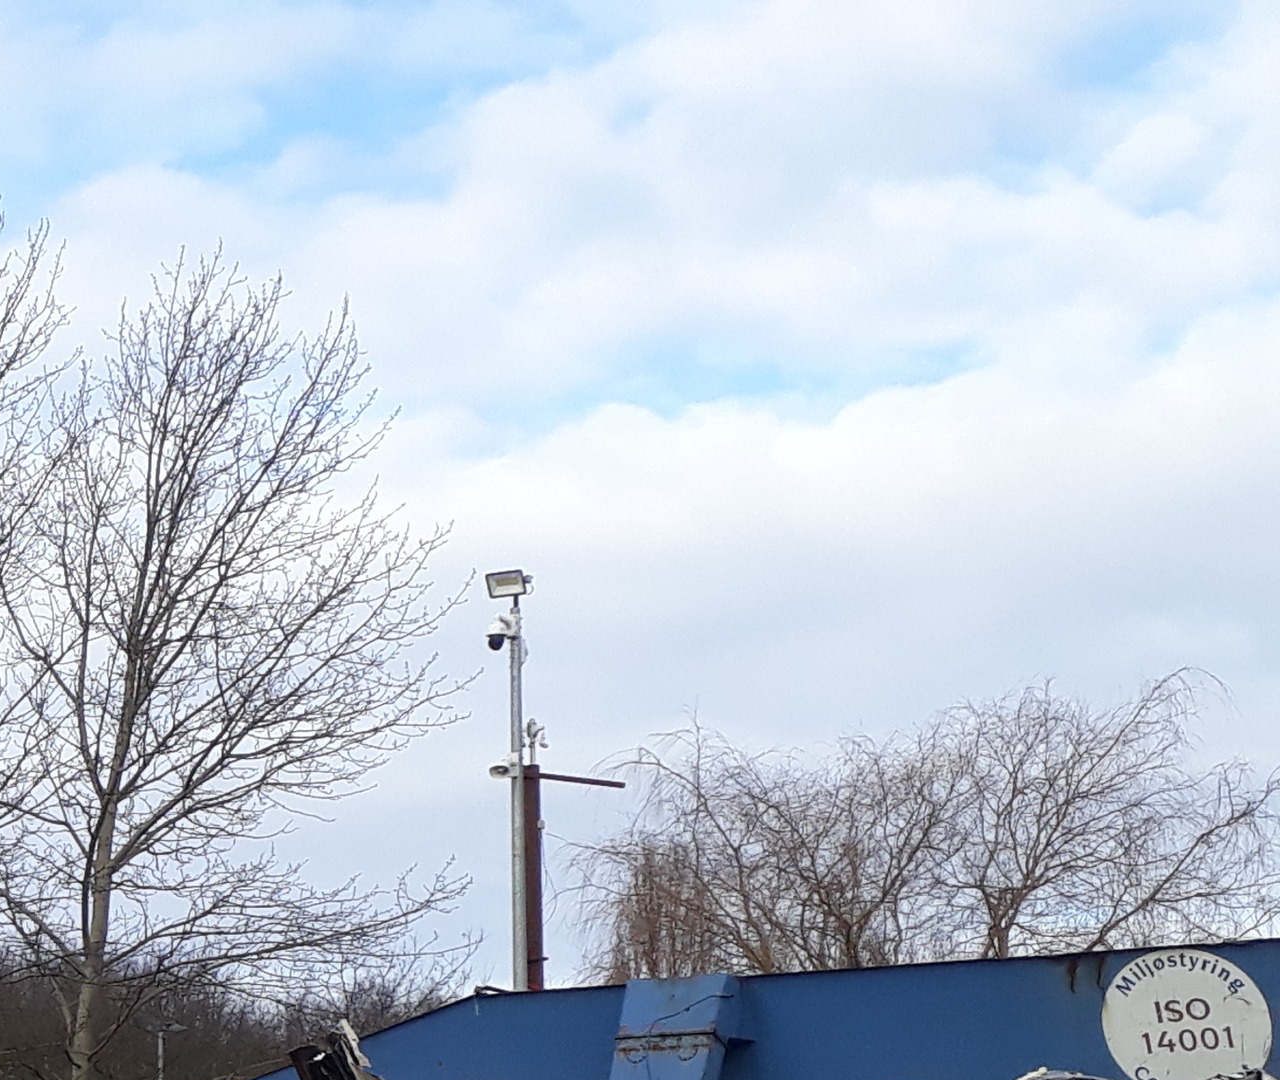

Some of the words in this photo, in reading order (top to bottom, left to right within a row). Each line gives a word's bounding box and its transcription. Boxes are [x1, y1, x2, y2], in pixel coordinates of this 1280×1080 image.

[1115, 952, 1245, 997] Miljøstyring
[1154, 997, 1211, 1024] ISO
[1141, 1026, 1235, 1055] 14001
